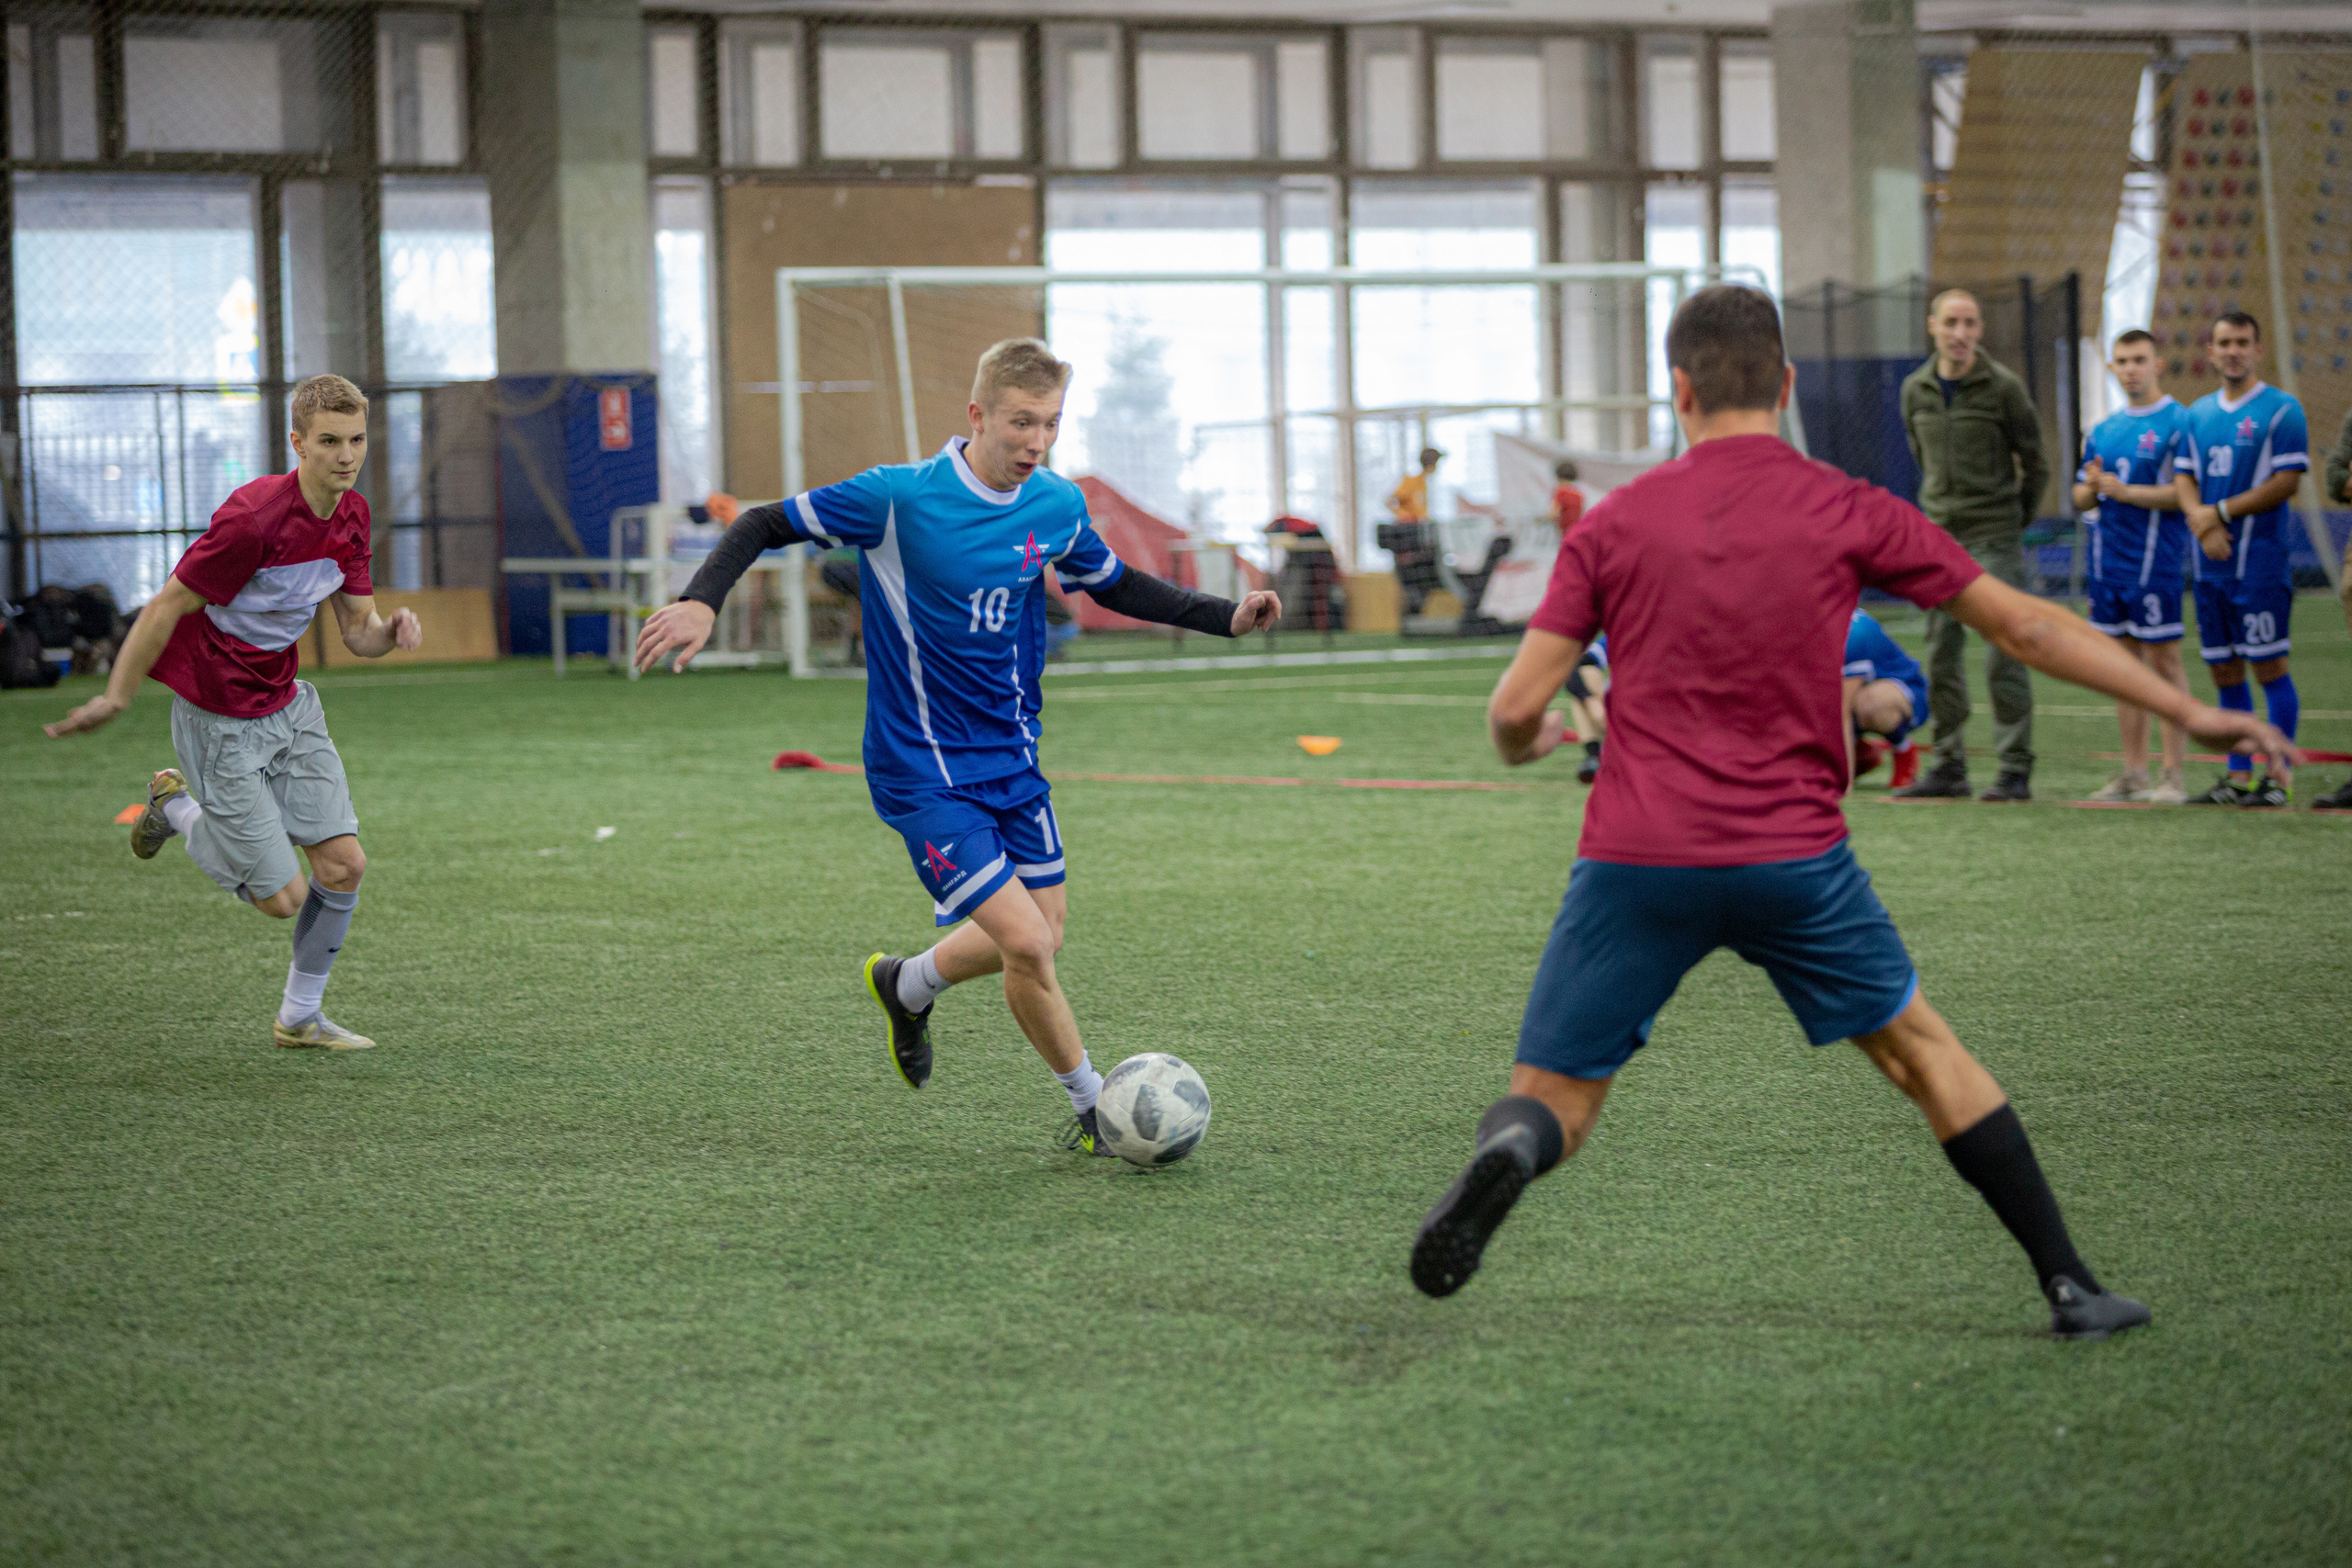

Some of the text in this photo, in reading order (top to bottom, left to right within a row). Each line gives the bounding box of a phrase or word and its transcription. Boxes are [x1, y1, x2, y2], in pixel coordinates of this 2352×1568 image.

[2207, 445, 2233, 477] 20
[968, 587, 1010, 633] 10
[2143, 593, 2163, 626] 3
[2243, 611, 2276, 644] 20
